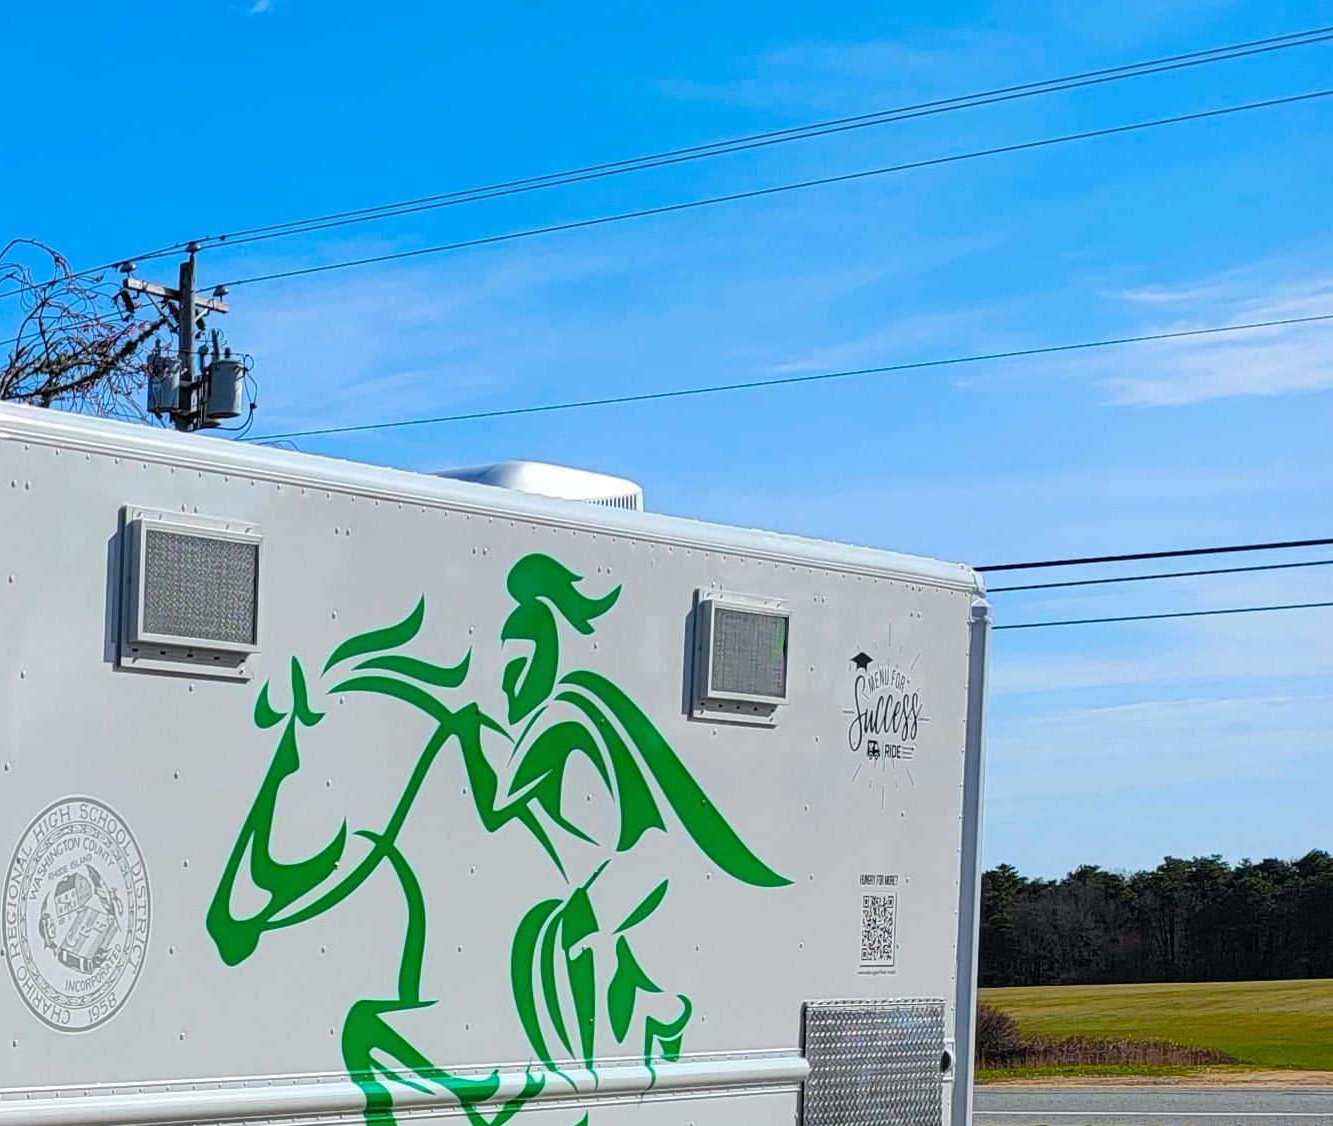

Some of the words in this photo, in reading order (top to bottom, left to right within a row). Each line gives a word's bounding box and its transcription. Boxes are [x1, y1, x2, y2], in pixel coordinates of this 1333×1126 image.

[868, 668, 890, 693] MENU
[891, 669, 907, 693] FOR
[849, 674, 923, 752] Success
[884, 744, 902, 759] RIDE
[32, 804, 72, 844] HIGH
[79, 803, 133, 857] SCHOOL
[28, 836, 81, 901] WASHINGTON
[82, 836, 115, 868] COUNTY
[47, 864, 69, 881] RHODE
[69, 852, 93, 870] ISLAND
[6, 846, 34, 960] REGIONAL
[128, 859, 148, 975] DISTRICT
[64, 943, 122, 992] INCORPORATED
[16, 965, 71, 1025] CHARIHO
[87, 992, 118, 1023] 1958
